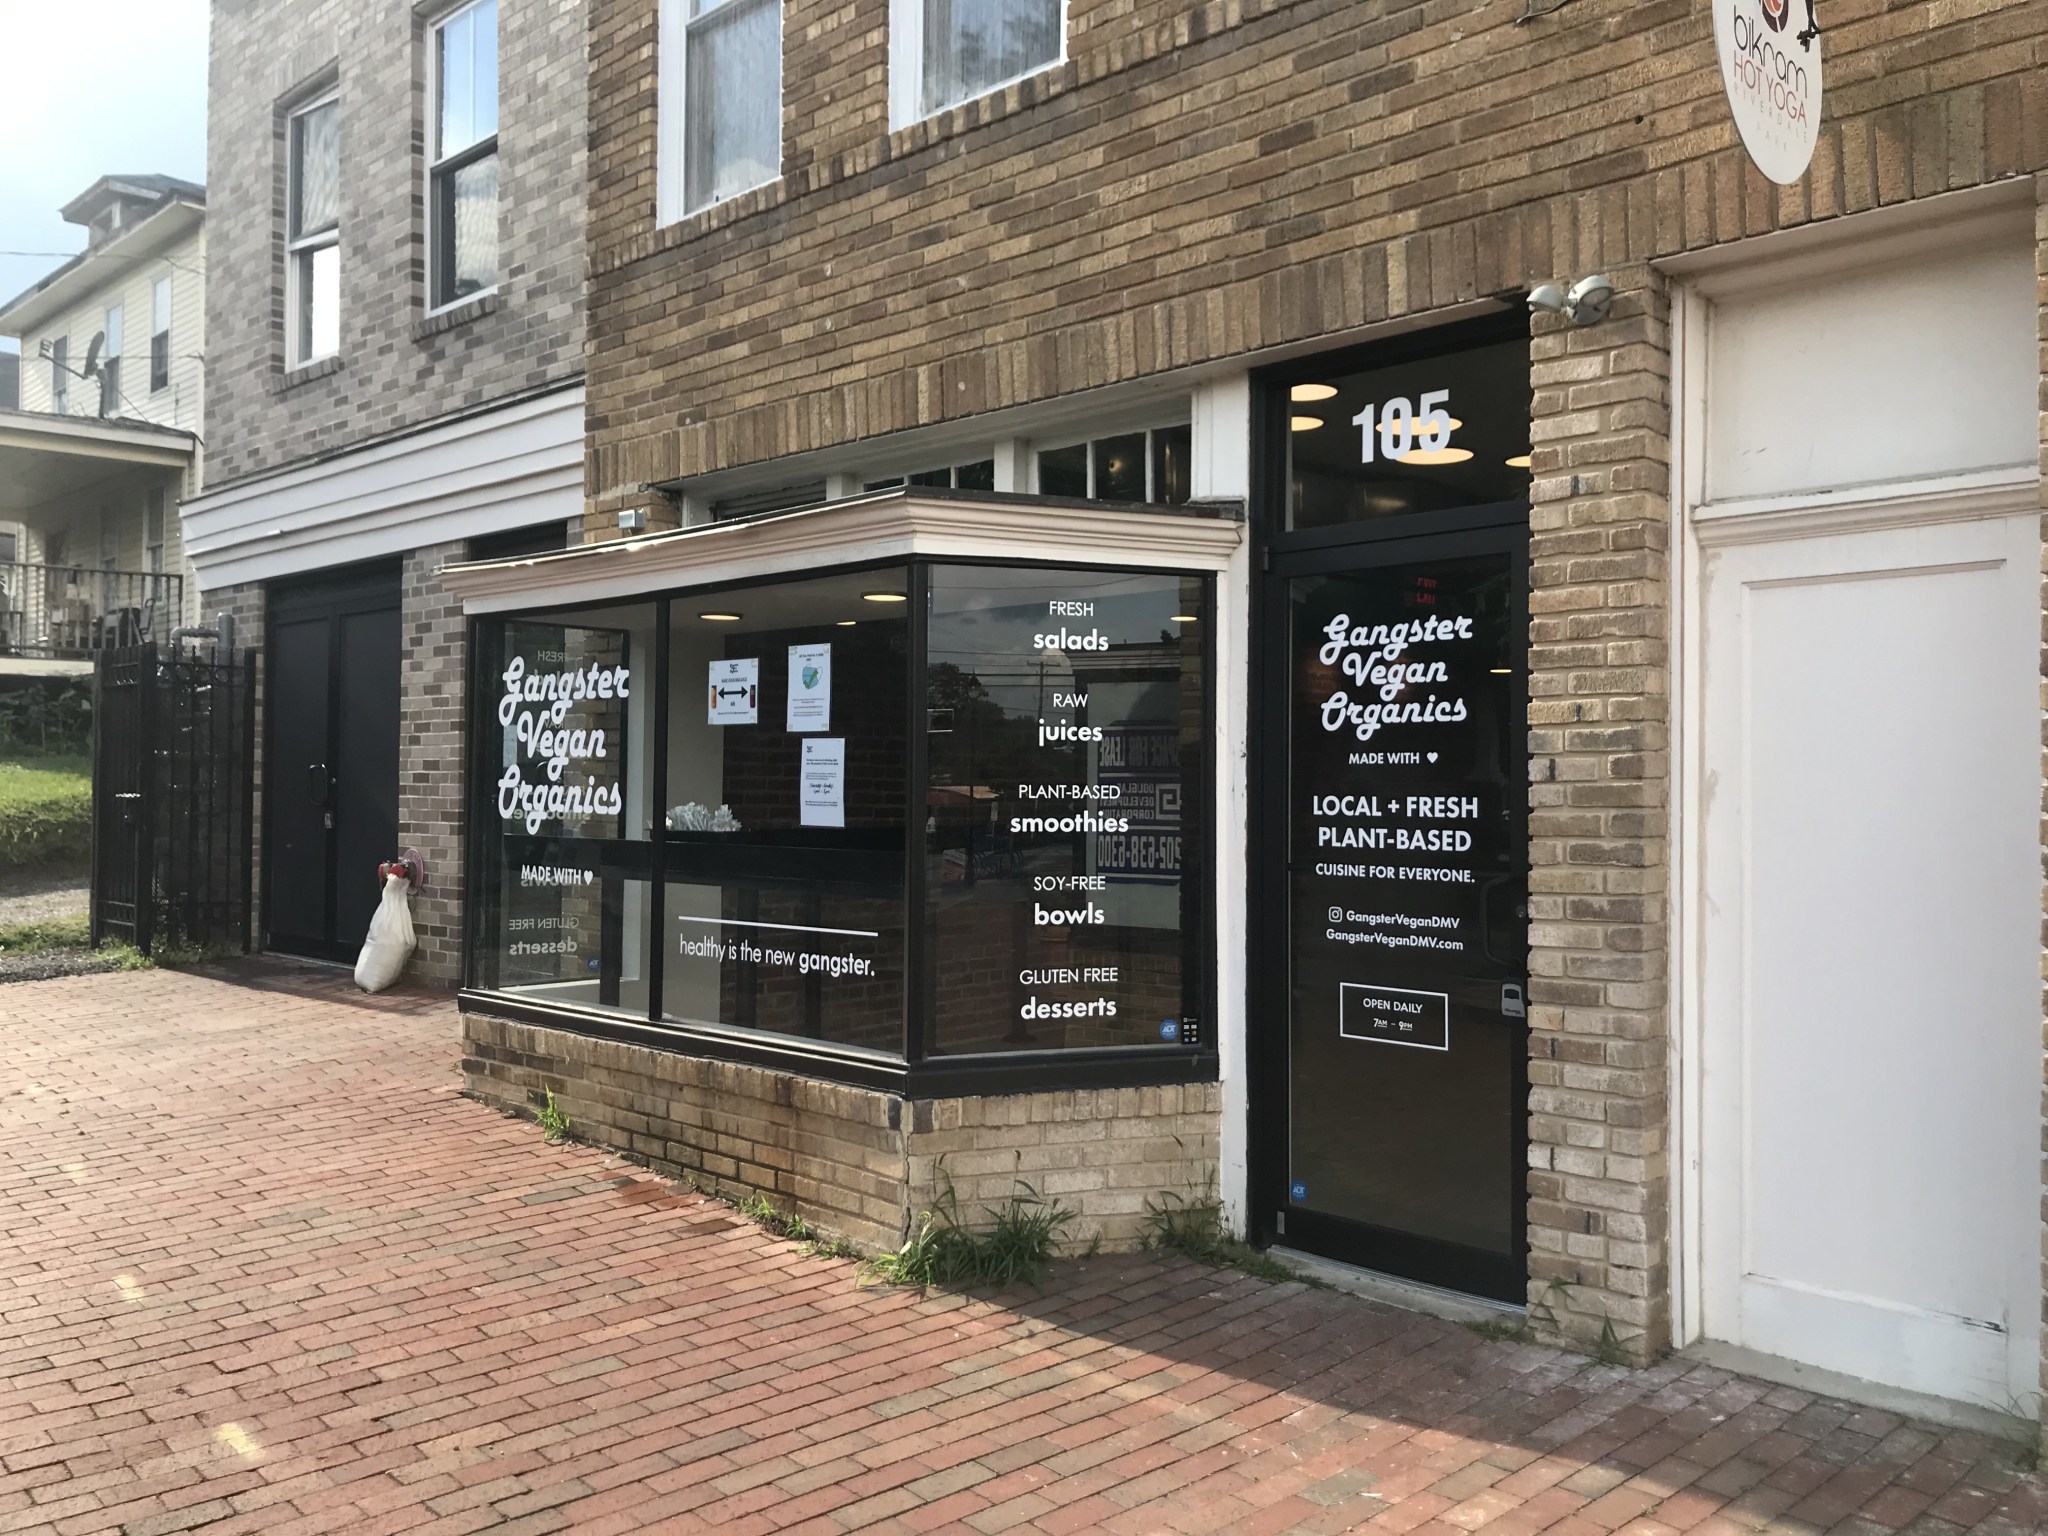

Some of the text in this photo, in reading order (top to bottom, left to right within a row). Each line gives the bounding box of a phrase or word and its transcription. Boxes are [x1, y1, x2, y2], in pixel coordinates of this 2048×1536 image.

[1734, 5, 1807, 98] bikram
[1734, 50, 1807, 128] HOT YOGA
[1352, 388, 1451, 464] 105
[1050, 601, 1094, 616] FRESH
[1033, 627, 1109, 651] salads
[1319, 614, 1473, 665] Gangster
[1342, 652, 1448, 701] Vegan
[498, 656, 630, 726] Gangster
[1053, 693, 1088, 708] RAW
[1320, 691, 1467, 741] Organics
[1038, 718, 1103, 746] juices
[517, 710, 607, 781] Vegan
[1348, 752, 1420, 764] MADE WITH
[498, 764, 622, 835] Organics
[1018, 785, 1121, 799] PLANT-BASED
[1313, 795, 1478, 818] LOCAL + FRESH
[1010, 810, 1129, 832] smoothies
[1318, 827, 1472, 851] PLANT-BASED
[521, 864, 551, 882] MADE
[554, 867, 581, 885] WITH
[1033, 876, 1106, 891] SOY-FREE
[1315, 863, 1475, 883] CUISINE FOR EVERYONE.
[1034, 902, 1104, 925] bowls
[1346, 910, 1460, 928] GangsterVeganDMV
[1326, 929, 1463, 950] GangsterVeganDMV.com
[680, 933, 875, 977] healthy is the new gangster.
[1019, 967, 1118, 985] GLUTEN FREE
[1020, 996, 1117, 1019] desserts
[1363, 998, 1423, 1014] OPEN DAILY
[1162, 1025, 1176, 1033] ADT
[1373, 1018, 1388, 1028] 7AM
[1398, 1021, 1413, 1031] 9PM
[1293, 1186, 1305, 1194] ADT
